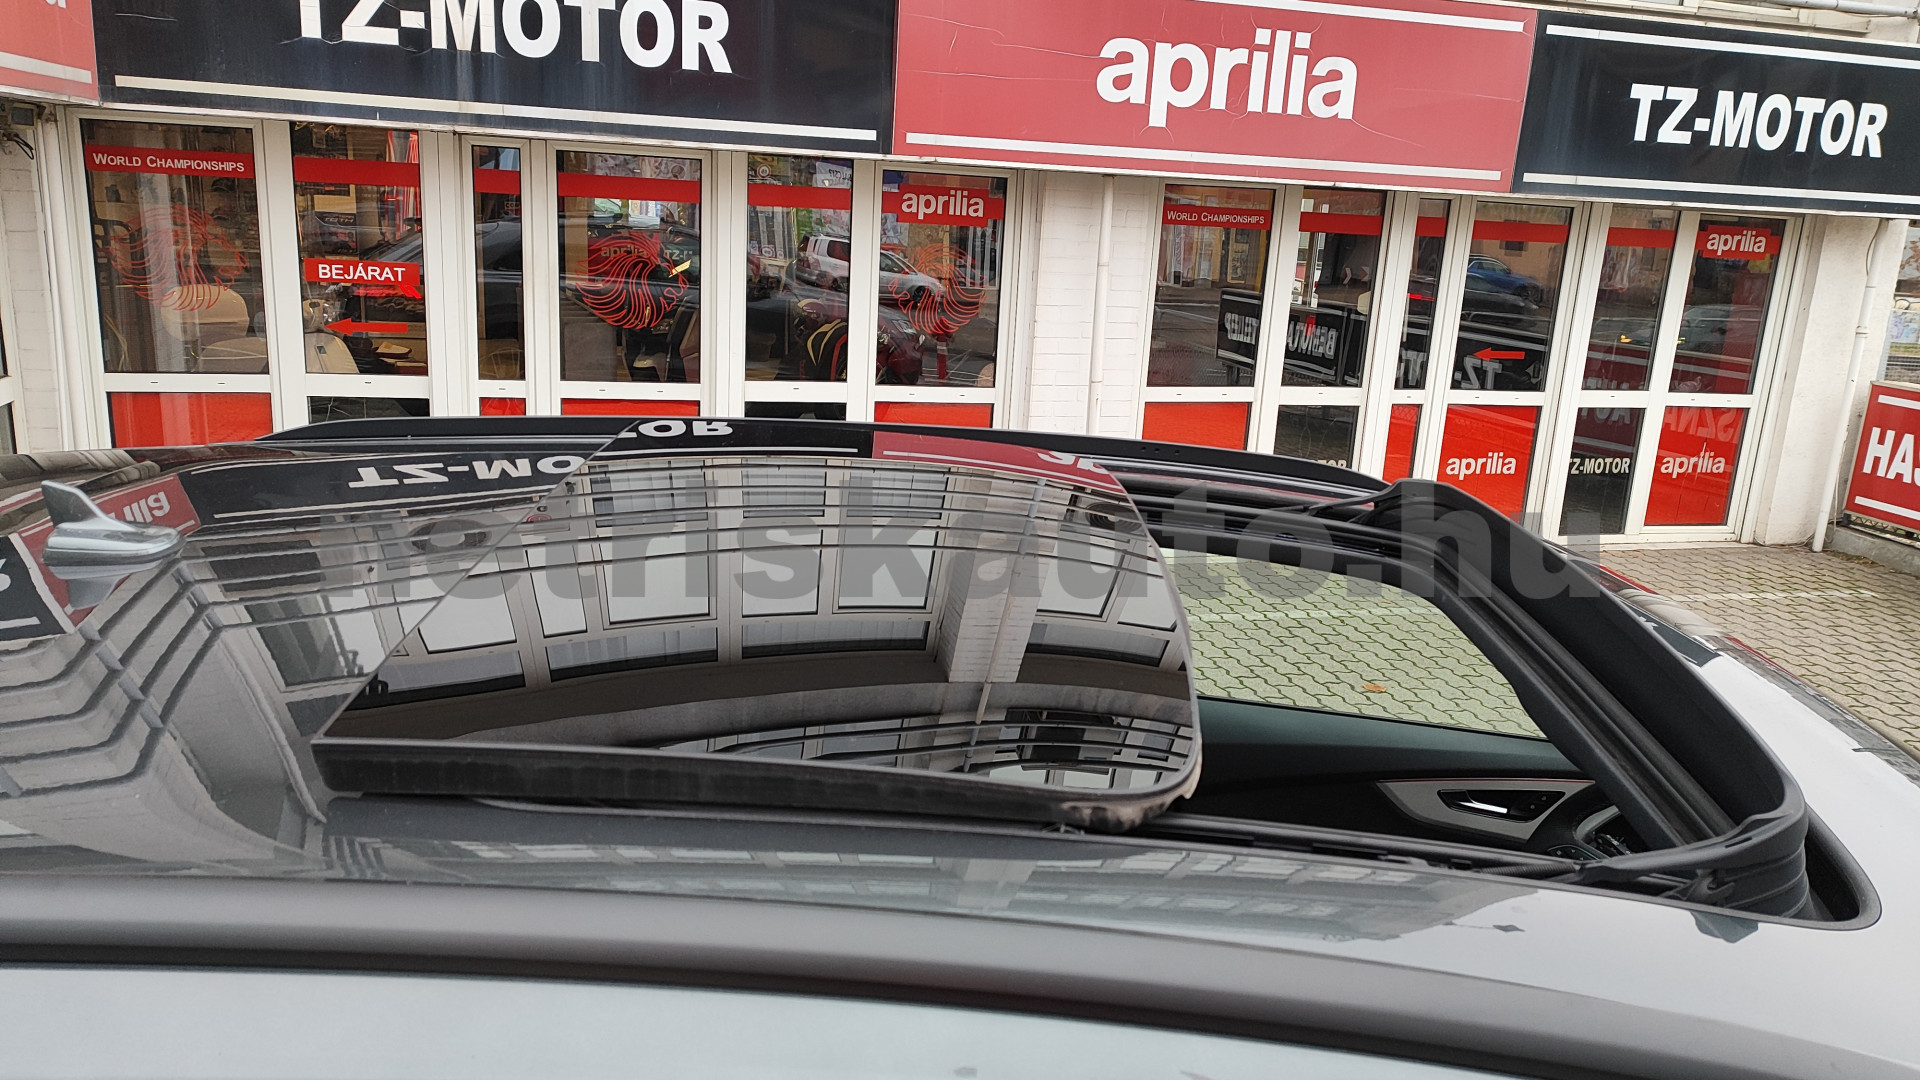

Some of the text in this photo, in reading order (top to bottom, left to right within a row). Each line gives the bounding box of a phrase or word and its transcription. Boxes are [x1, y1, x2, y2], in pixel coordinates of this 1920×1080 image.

[1096, 27, 1358, 127] aprilia
[1630, 83, 1888, 158] TZ-MOTOR
[93, 152, 245, 172] WORLD CHAMPIONSHIPS
[901, 189, 985, 219] aprilia
[1167, 210, 1265, 224] WORLD CHAMPIONSHIPS
[1706, 230, 1767, 255] aprilia
[318, 262, 406, 281] BEJÁRAT
[1446, 451, 1516, 480] aprilia
[1569, 457, 1631, 475] Z-MOTOR
[1660, 451, 1725, 478] aprilia
[1862, 426, 1920, 487] HA
